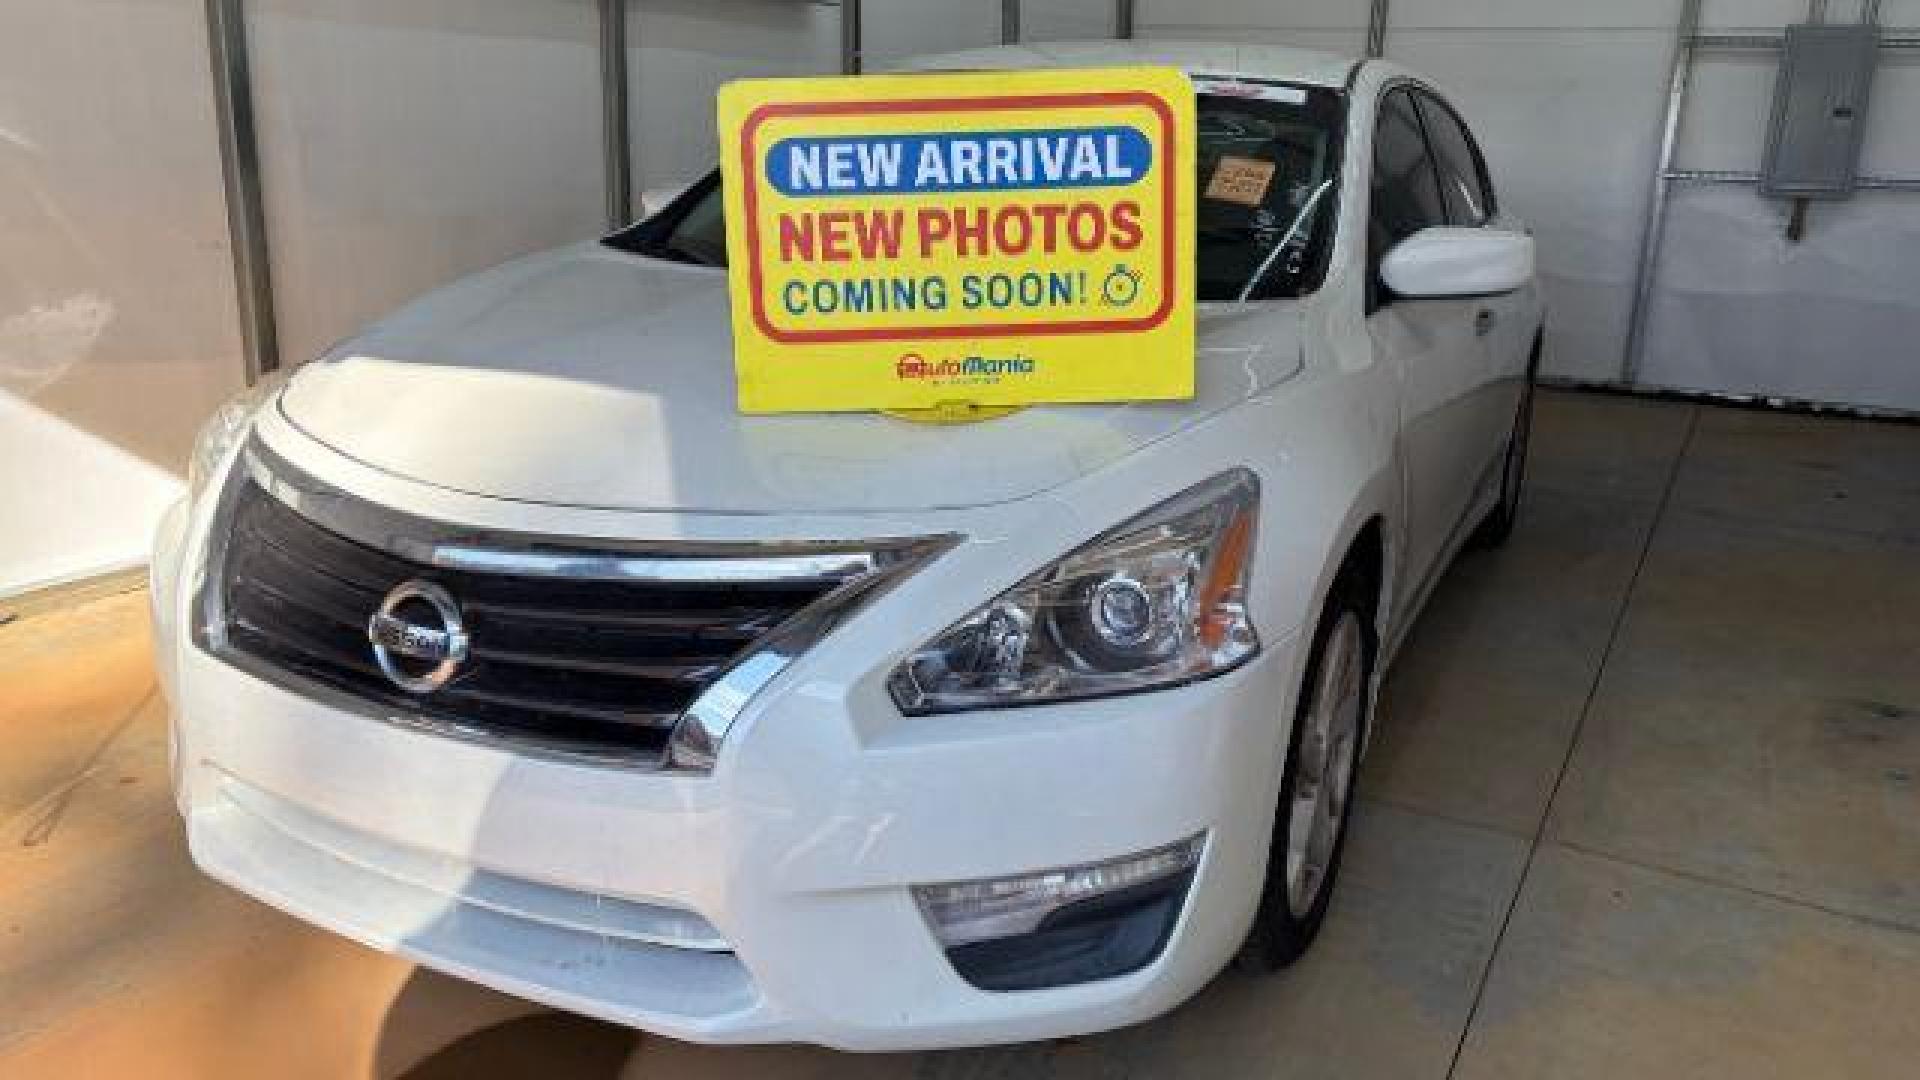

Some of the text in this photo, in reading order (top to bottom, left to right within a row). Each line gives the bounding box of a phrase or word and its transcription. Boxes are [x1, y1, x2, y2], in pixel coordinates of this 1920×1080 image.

[789, 135, 1132, 190] NEW ARRIVAL
[779, 202, 1143, 261] NEW PHOTOS
[783, 270, 1088, 315] COMING SOON!
